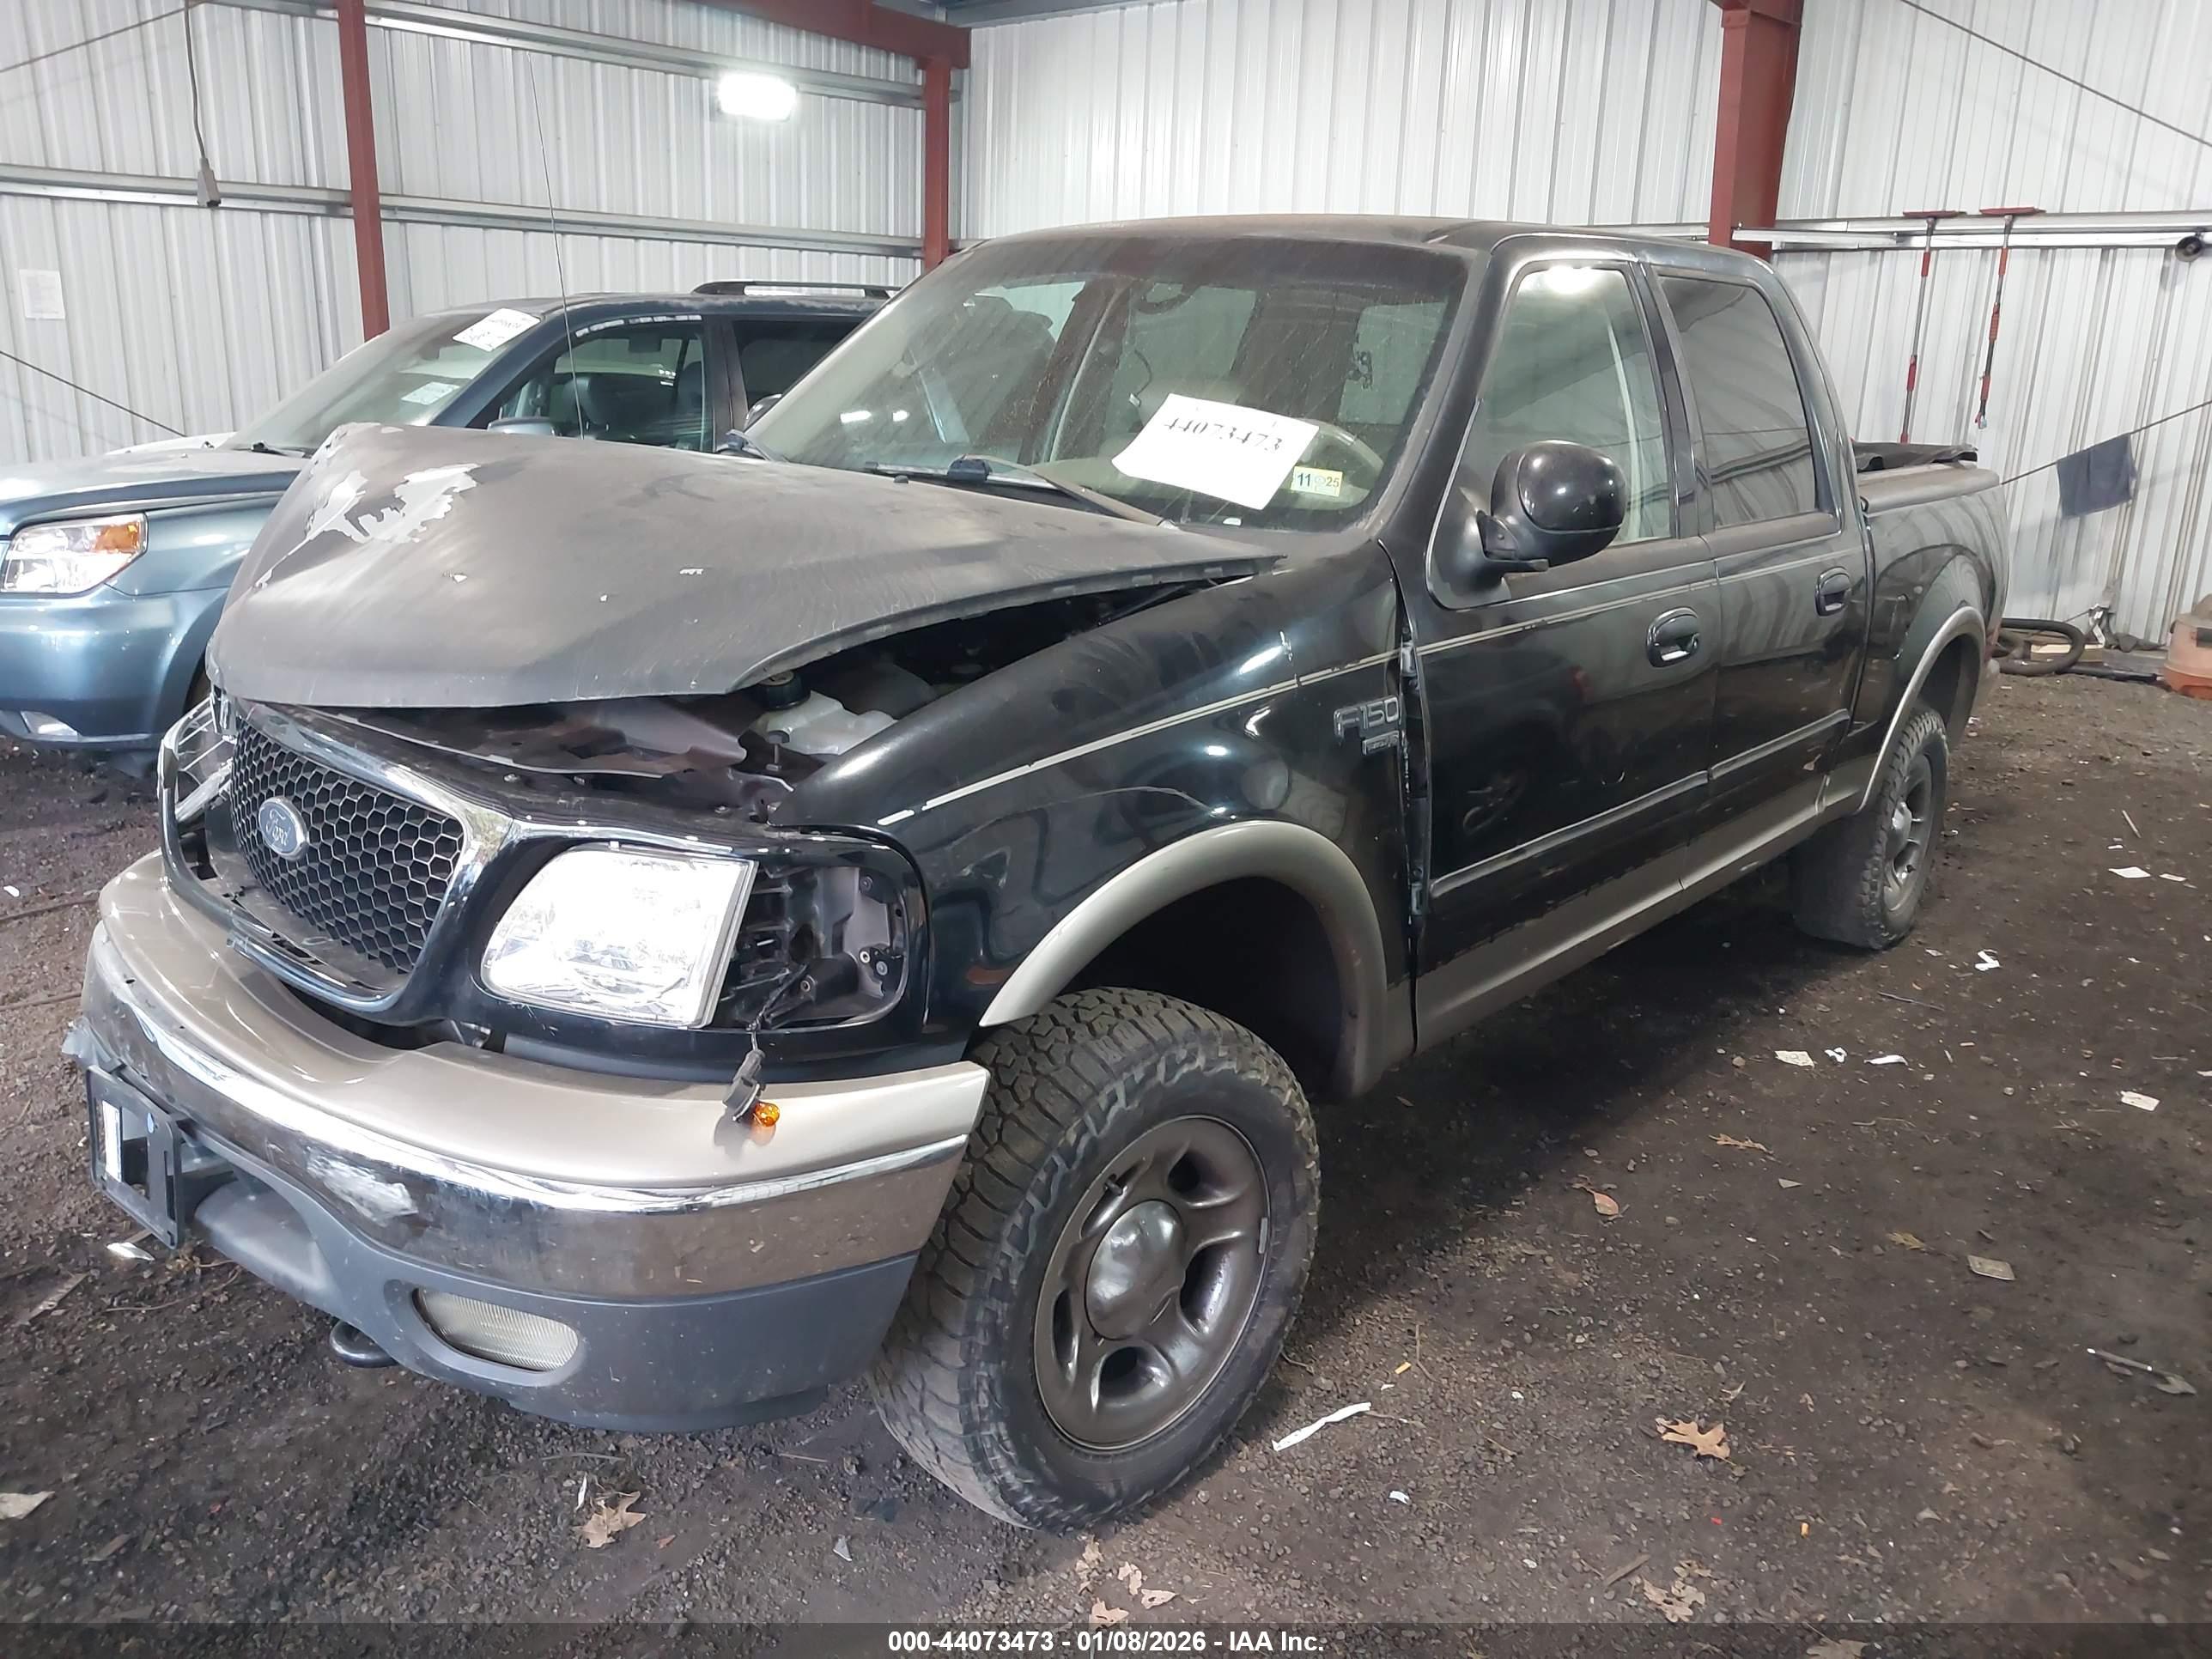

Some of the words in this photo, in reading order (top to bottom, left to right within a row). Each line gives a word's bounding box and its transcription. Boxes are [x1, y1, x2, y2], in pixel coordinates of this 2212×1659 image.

[1164, 417, 1283, 453] 44073473
[1297, 473, 1311, 487] 11
[1325, 476, 1340, 488] 25
[265, 808, 292, 846] Ford
